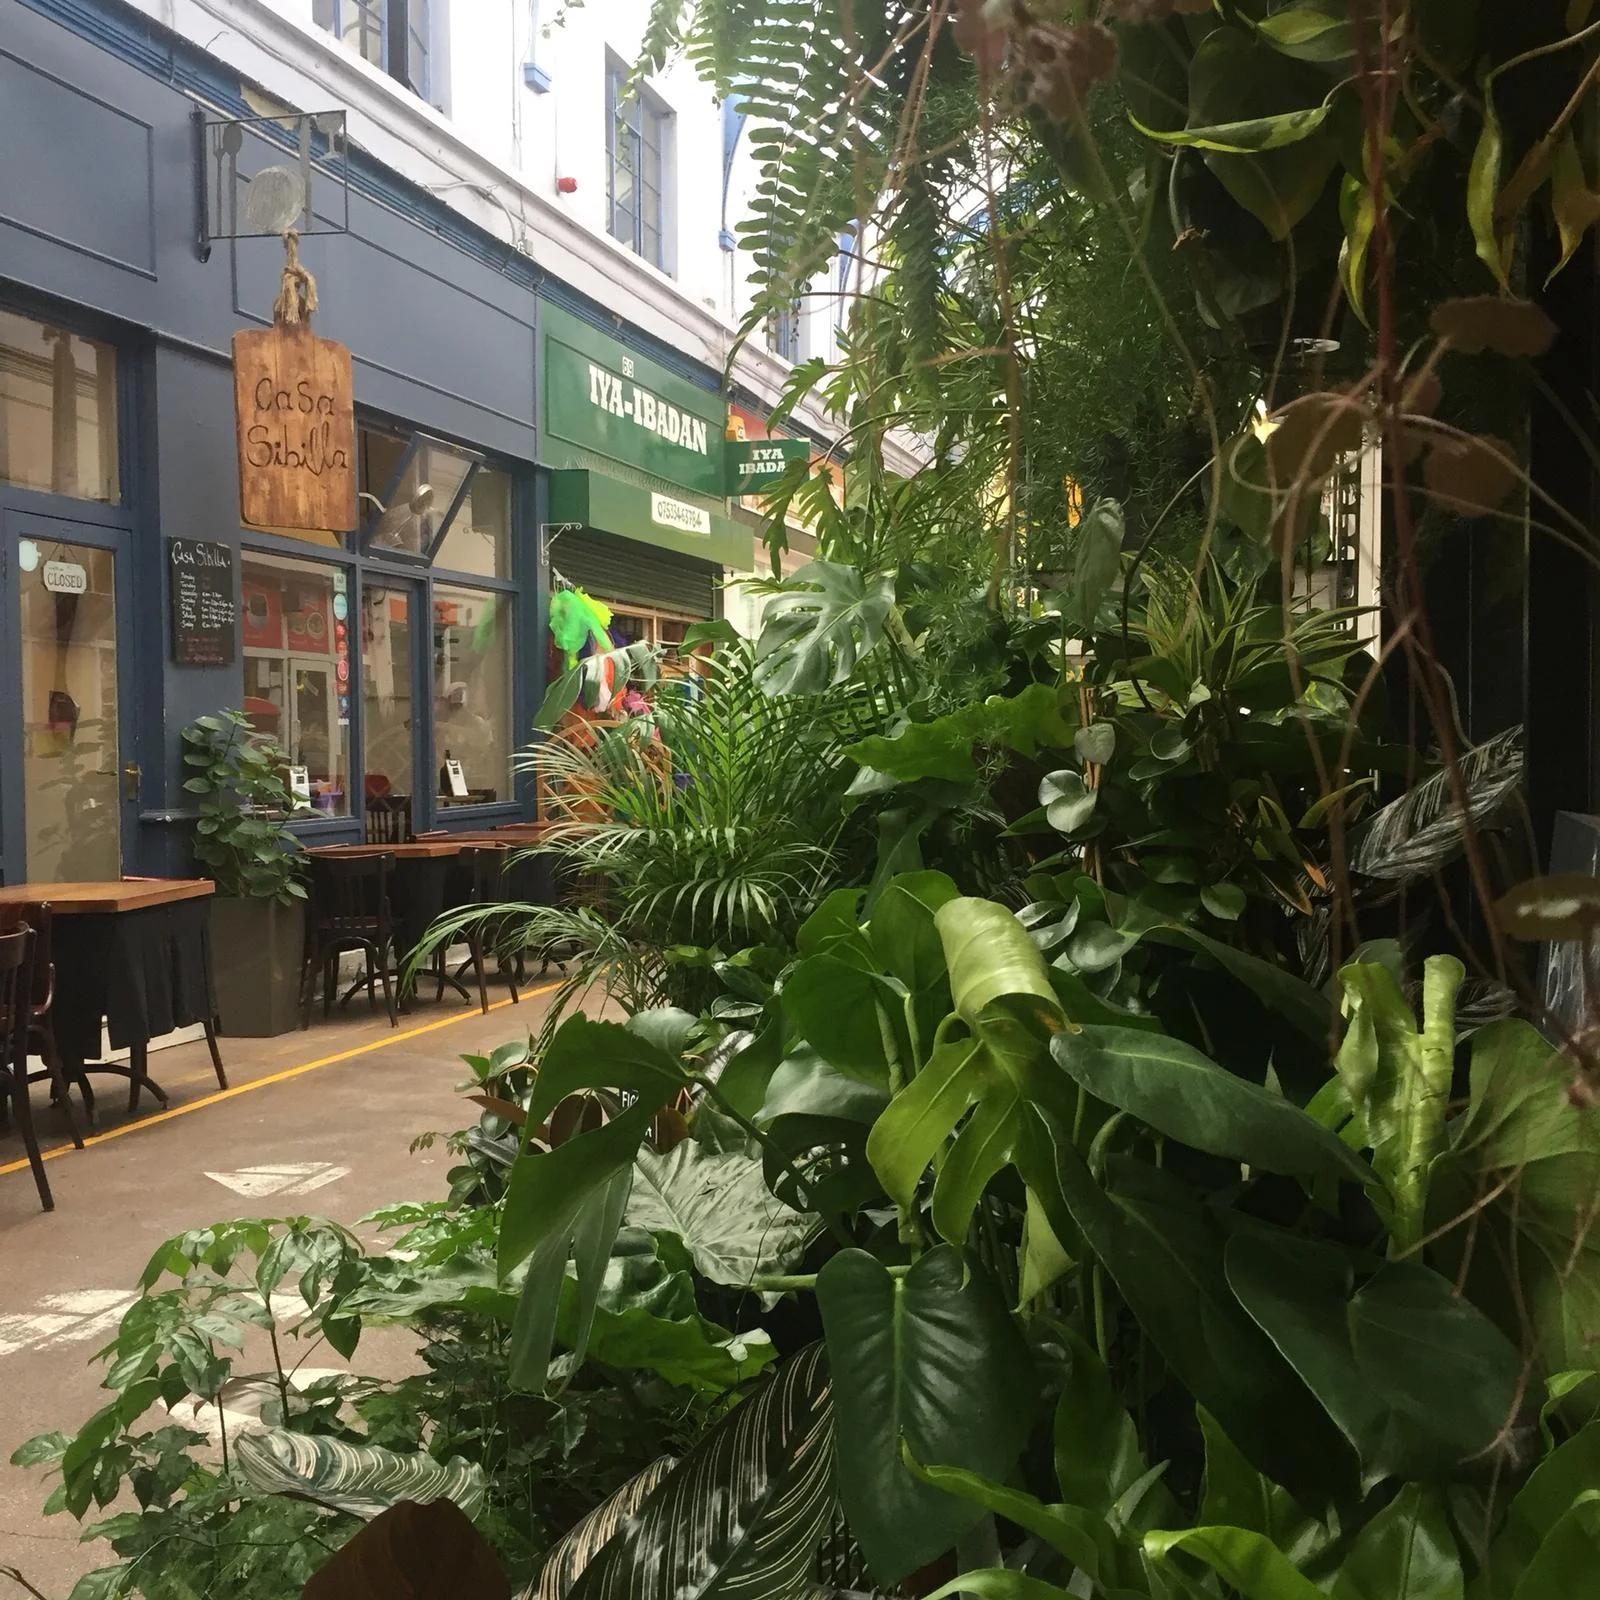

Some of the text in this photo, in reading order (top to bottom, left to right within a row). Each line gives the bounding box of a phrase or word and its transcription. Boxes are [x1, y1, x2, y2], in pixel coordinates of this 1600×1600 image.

[588, 364, 707, 456] IYA-IBADAN
[247, 421, 347, 476] Sibilla
[752, 448, 784, 461] IYA
[738, 461, 786, 475] IBADA
[47, 572, 83, 589] CLOSED
[622, 1091, 636, 1108] FIC
